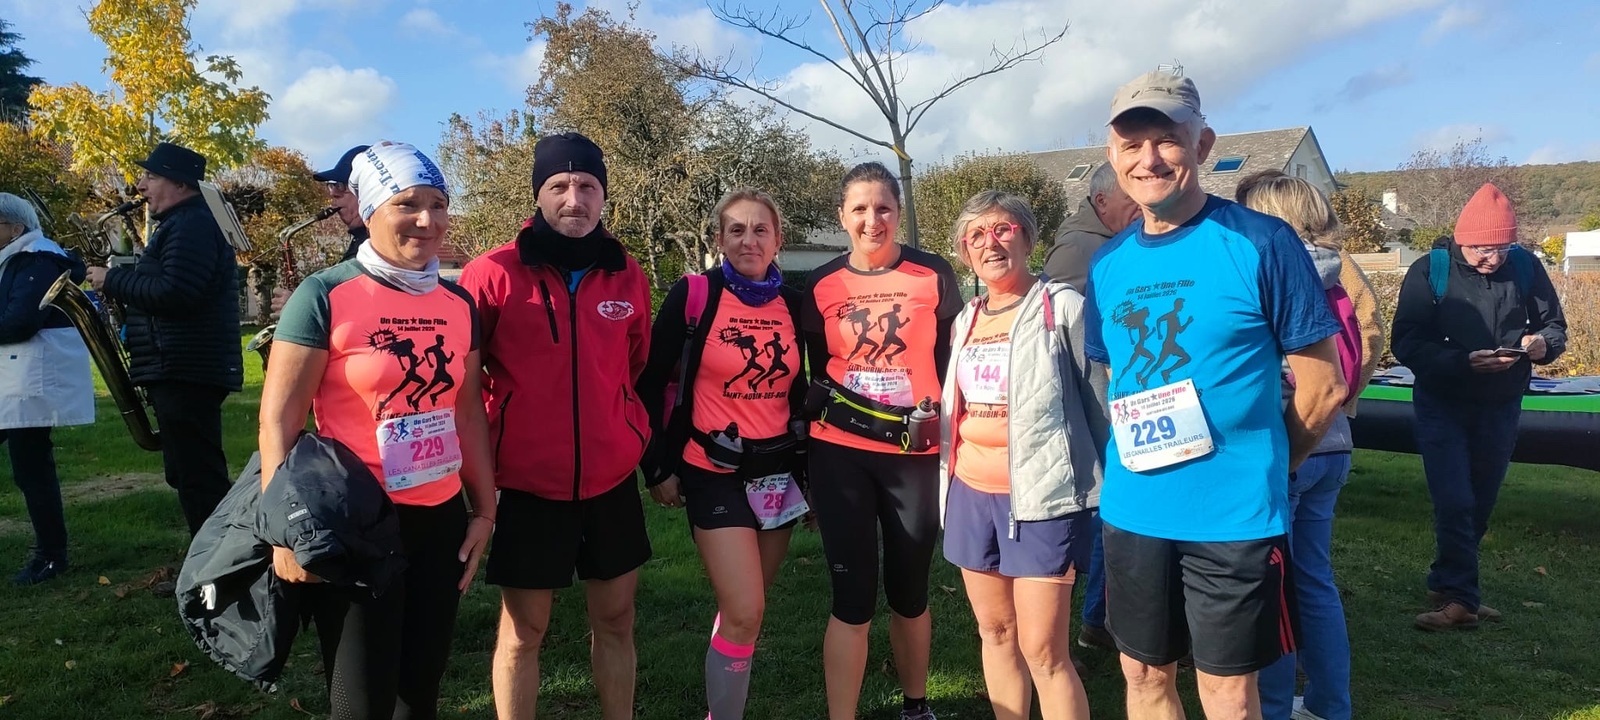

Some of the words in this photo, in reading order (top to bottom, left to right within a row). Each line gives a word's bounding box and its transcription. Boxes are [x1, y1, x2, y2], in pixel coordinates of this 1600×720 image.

[380, 317, 391, 325] Un
[392, 317, 409, 325] Gars
[433, 318, 447, 326] Fille
[973, 364, 1000, 382] 144
[1137, 397, 1151, 405] Gars
[1158, 391, 1171, 399] Une
[1130, 416, 1177, 447] 229
[410, 436, 444, 462] 229
[1132, 445, 1163, 457] CANAILLES
[1163, 433, 1204, 449] TRAILEURS
[388, 467, 402, 476] LES
